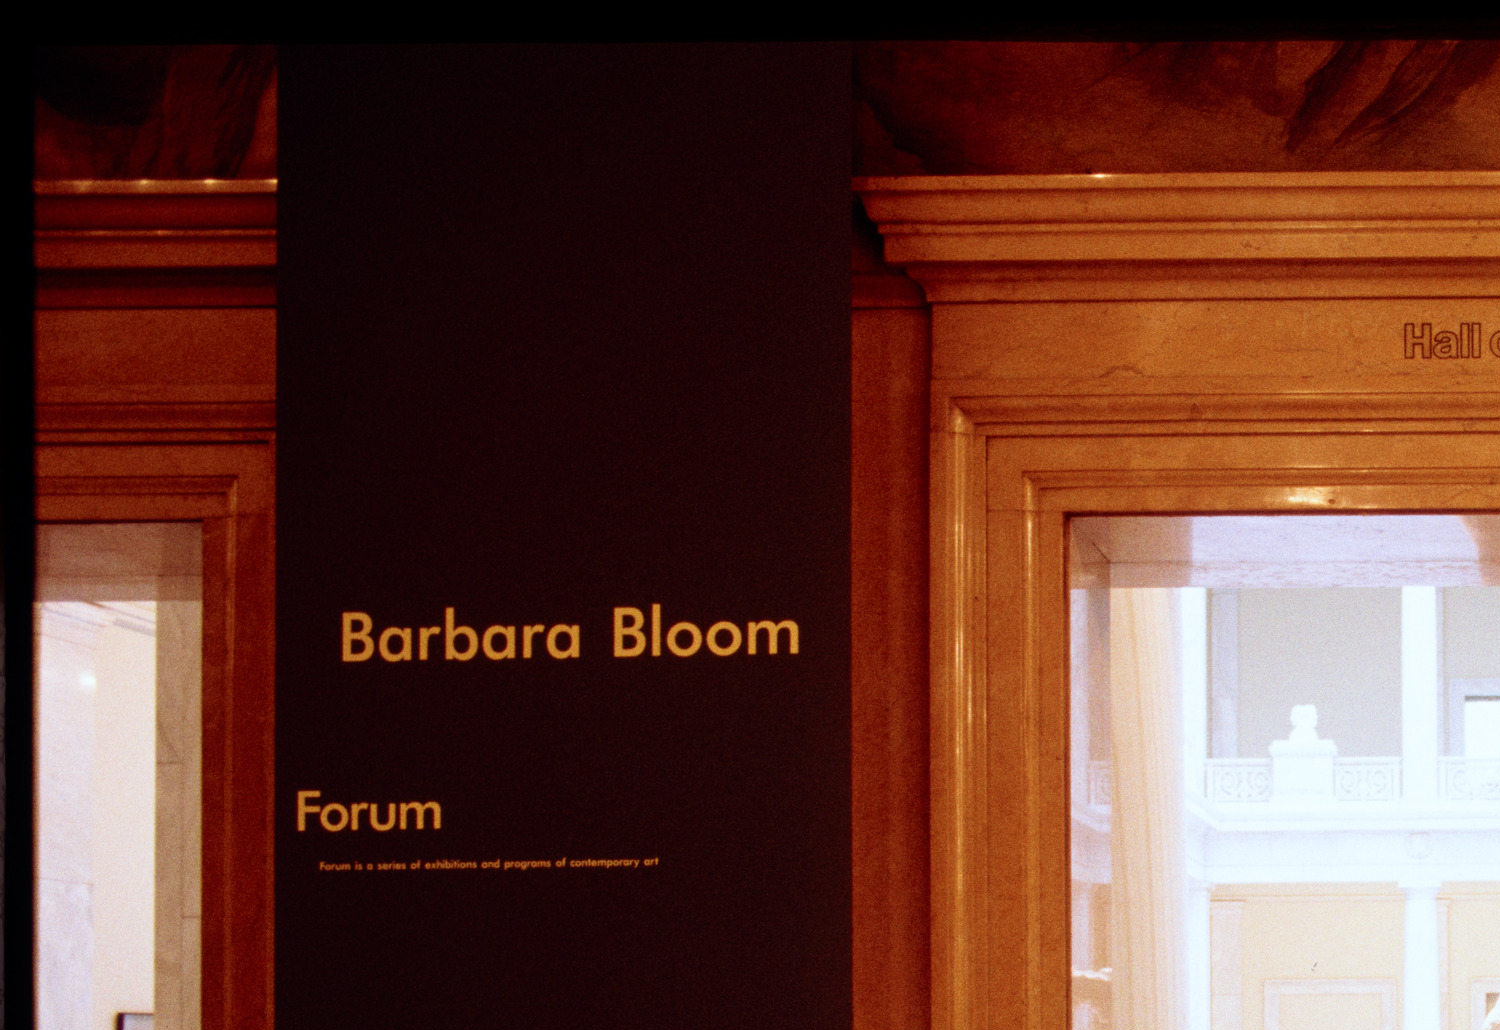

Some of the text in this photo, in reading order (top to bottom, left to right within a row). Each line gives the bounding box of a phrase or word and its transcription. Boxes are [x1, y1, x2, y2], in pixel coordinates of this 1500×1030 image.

[1403, 321, 1482, 360] Hall
[340, 602, 801, 664] Barbara Bloom
[295, 789, 443, 833] Forum
[318, 856, 660, 872] Forum is a series of exhibitions and programs of contemporary art
